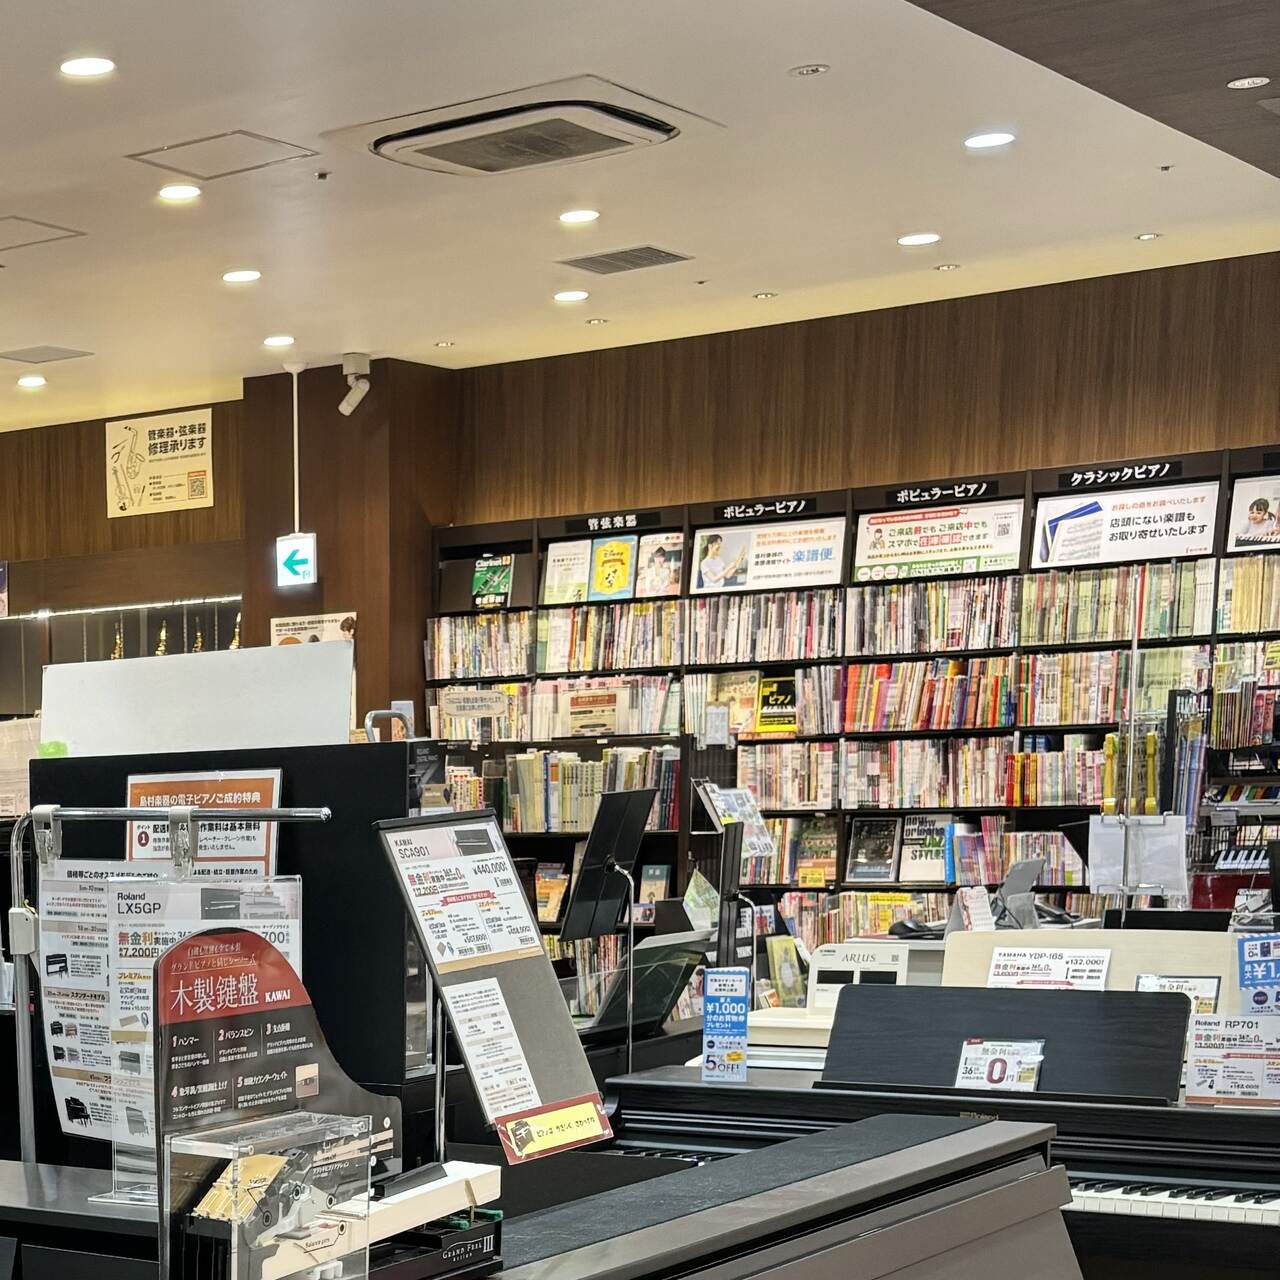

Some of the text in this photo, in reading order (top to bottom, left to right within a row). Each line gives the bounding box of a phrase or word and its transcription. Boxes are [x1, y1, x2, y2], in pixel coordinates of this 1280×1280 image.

[148, 423, 206, 441] 管楽器・弦楽器
[148, 437, 206, 456] 修理承ります
[1071, 463, 1172, 487] クラシックピアノ
[897, 483, 987, 504] ポピュラーピアノ
[723, 500, 806, 518] ポピュラーピアノ
[588, 515, 638, 531] 管弦楽器
[939, 521, 988, 533] ご来店中でも
[1109, 512, 1196, 529] 店頭にない楽譜も
[1108, 524, 1208, 542] お取り寄せいたします
[117, 892, 145, 901] Roland
[117, 902, 162, 914] LX5GP
[118, 931, 153, 946] 無金利
[1253, 961, 1280, 980] ¥1,
[171, 973, 259, 1016] 木製鍵盤
[265, 989, 291, 1003] KAWAI
[706, 1002, 746, 1014] ¥1,000
[1195, 1019, 1220, 1027] Roland
[1225, 1020, 1259, 1030] RP701
[218, 1029, 225, 1041] 2
[986, 1057, 1008, 1084] 0
[171, 1086, 178, 1098] 4
